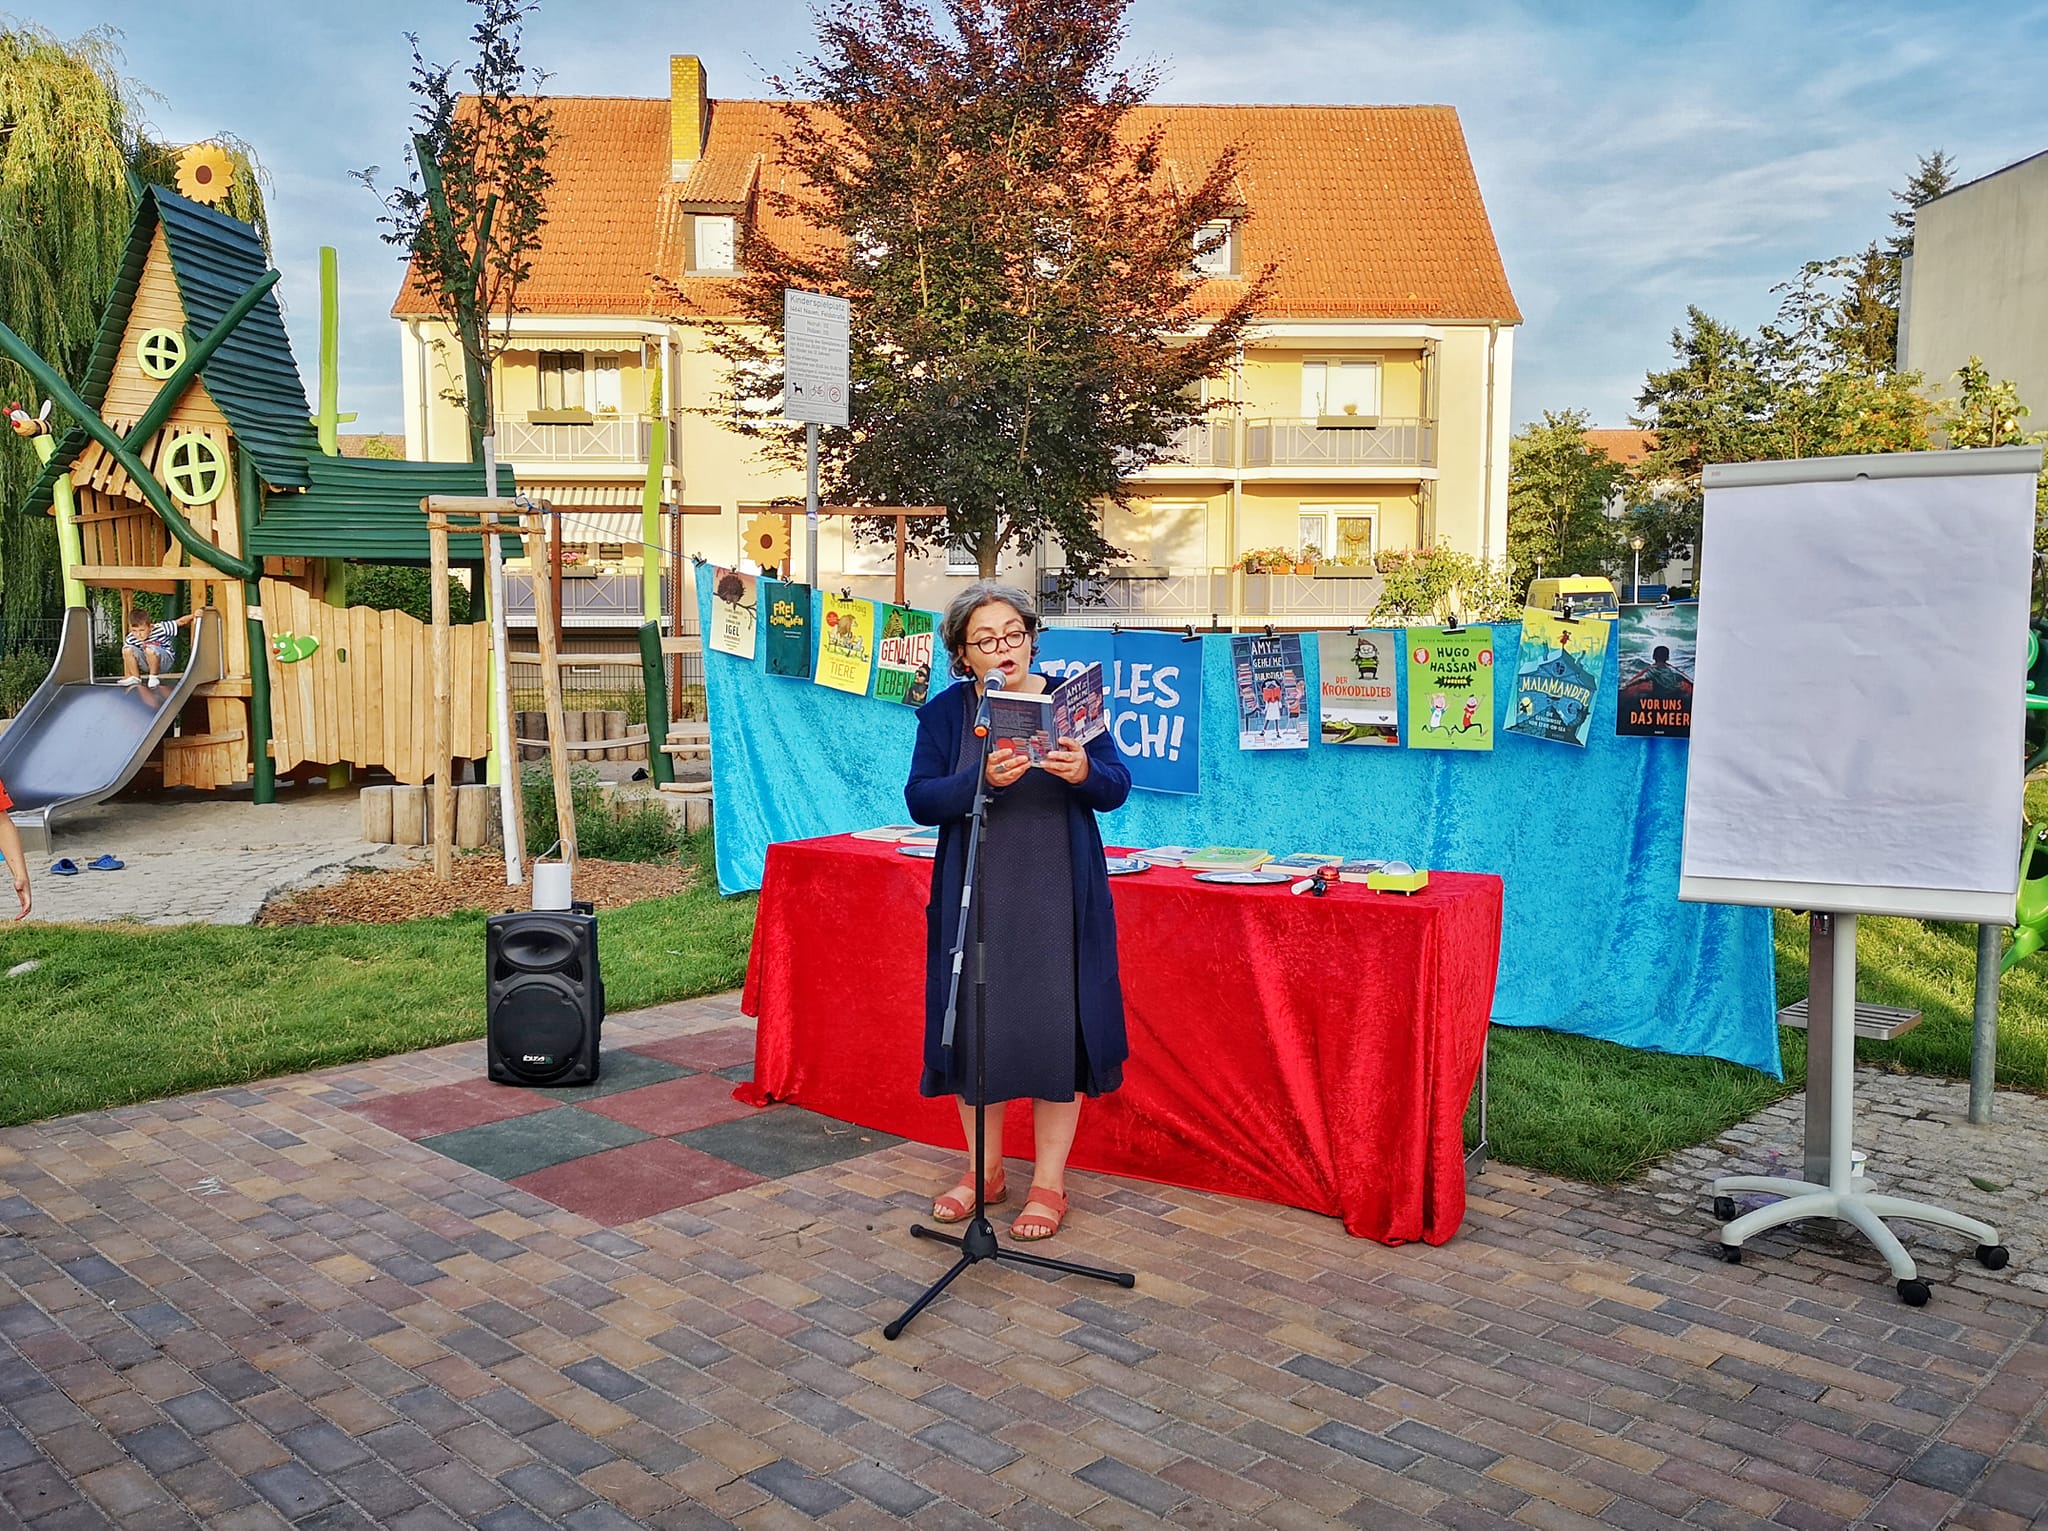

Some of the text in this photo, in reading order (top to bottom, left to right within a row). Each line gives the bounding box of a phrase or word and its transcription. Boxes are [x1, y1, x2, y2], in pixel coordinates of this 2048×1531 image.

[790, 294, 845, 312] Kinderspielplatz
[773, 600, 794, 618] FREI
[851, 602, 867, 617] Haig
[725, 623, 740, 637] IGEL
[907, 613, 932, 635] MEIN
[1251, 640, 1272, 655] AMY
[1436, 647, 1470, 658] HUGO
[830, 661, 857, 680] TIERE
[1430, 661, 1477, 673] HASSAN
[1039, 659, 1180, 709] TLES
[1335, 676, 1348, 684] DER
[1322, 681, 1392, 698] KROKODILDIEB
[1519, 677, 1591, 707] MALAMANDER
[1639, 698, 1682, 711] VOR UNS
[1630, 711, 1690, 727] DAS MEER
